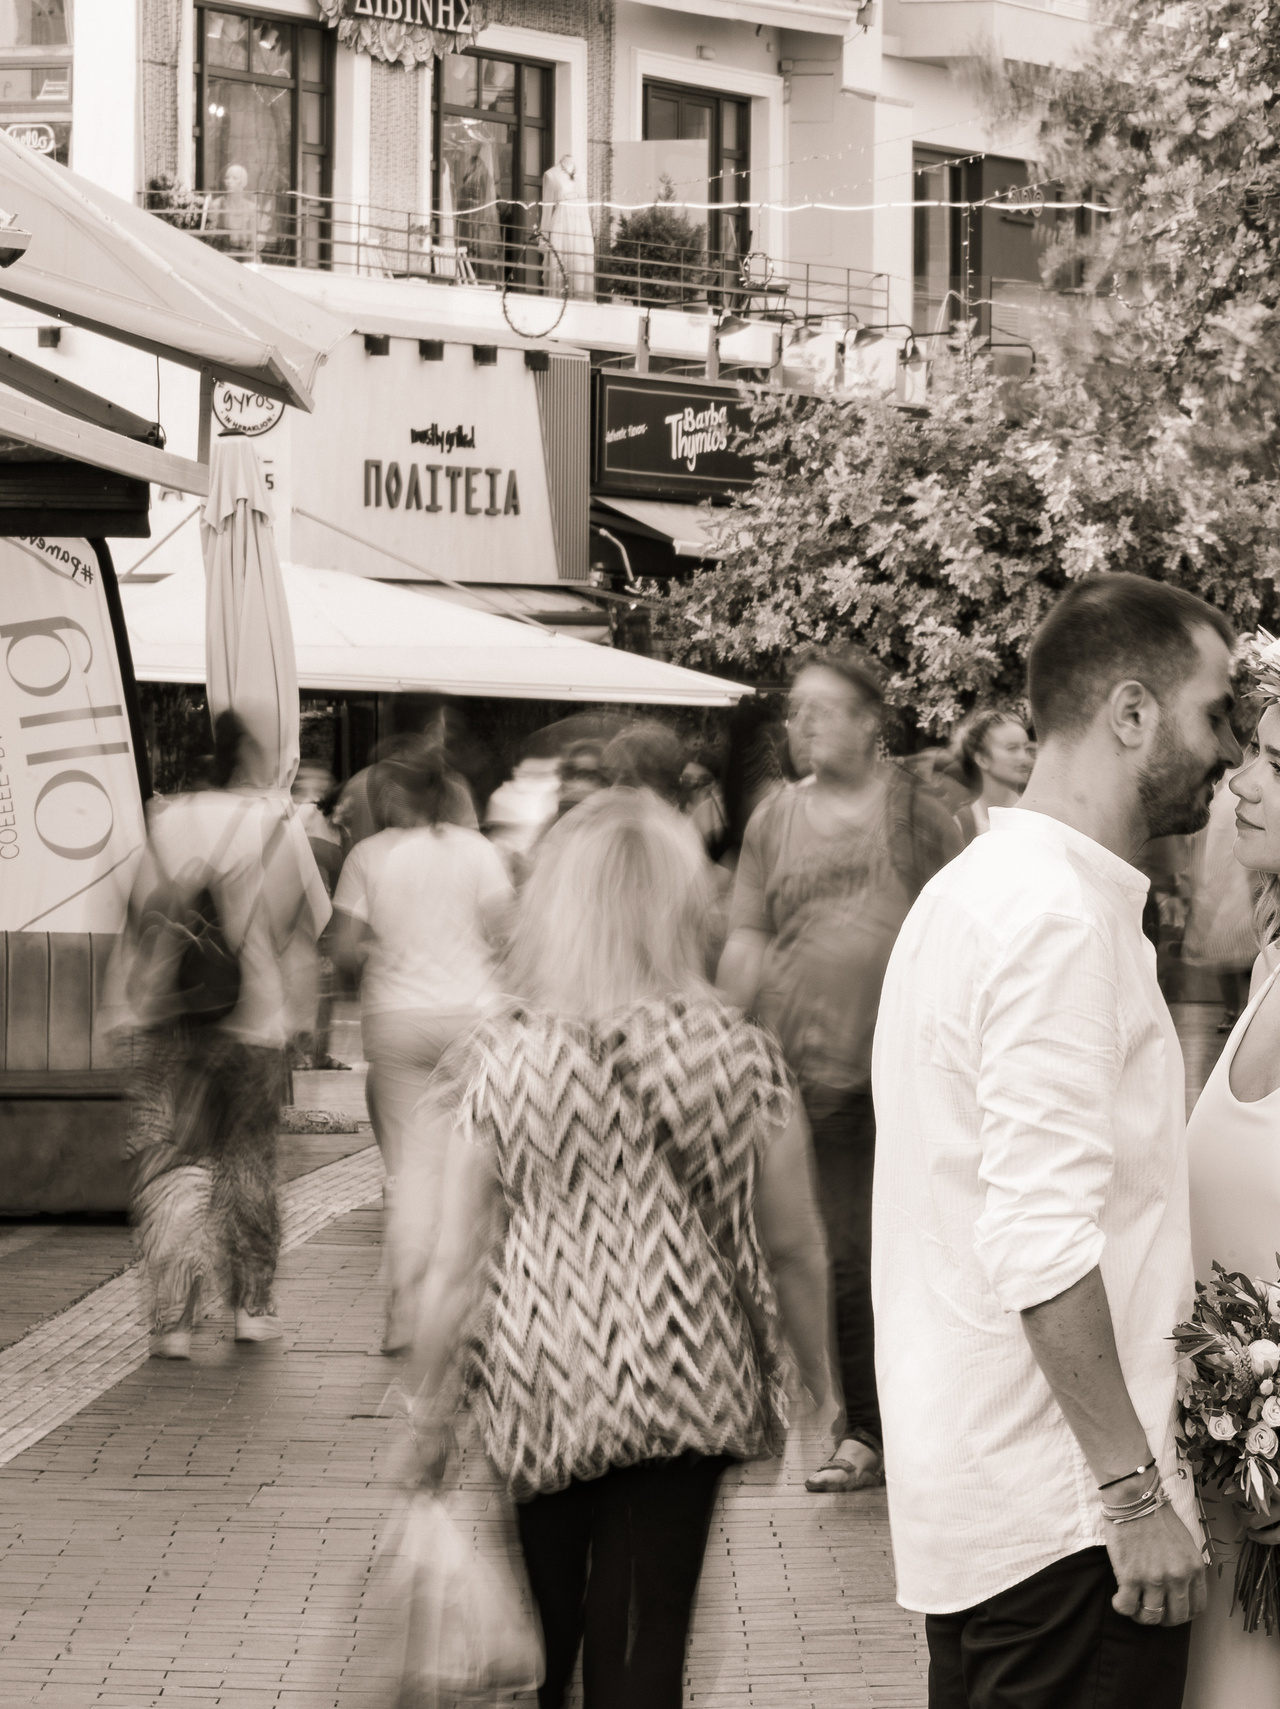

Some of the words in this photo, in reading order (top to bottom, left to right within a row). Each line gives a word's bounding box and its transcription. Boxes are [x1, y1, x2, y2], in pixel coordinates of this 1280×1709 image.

[223, 389, 275, 413] gyros
[683, 402, 728, 432] Barba
[665, 413, 728, 472] Thymios
[364, 459, 521, 516] ΠΟΛΙΤΕΙΑ
